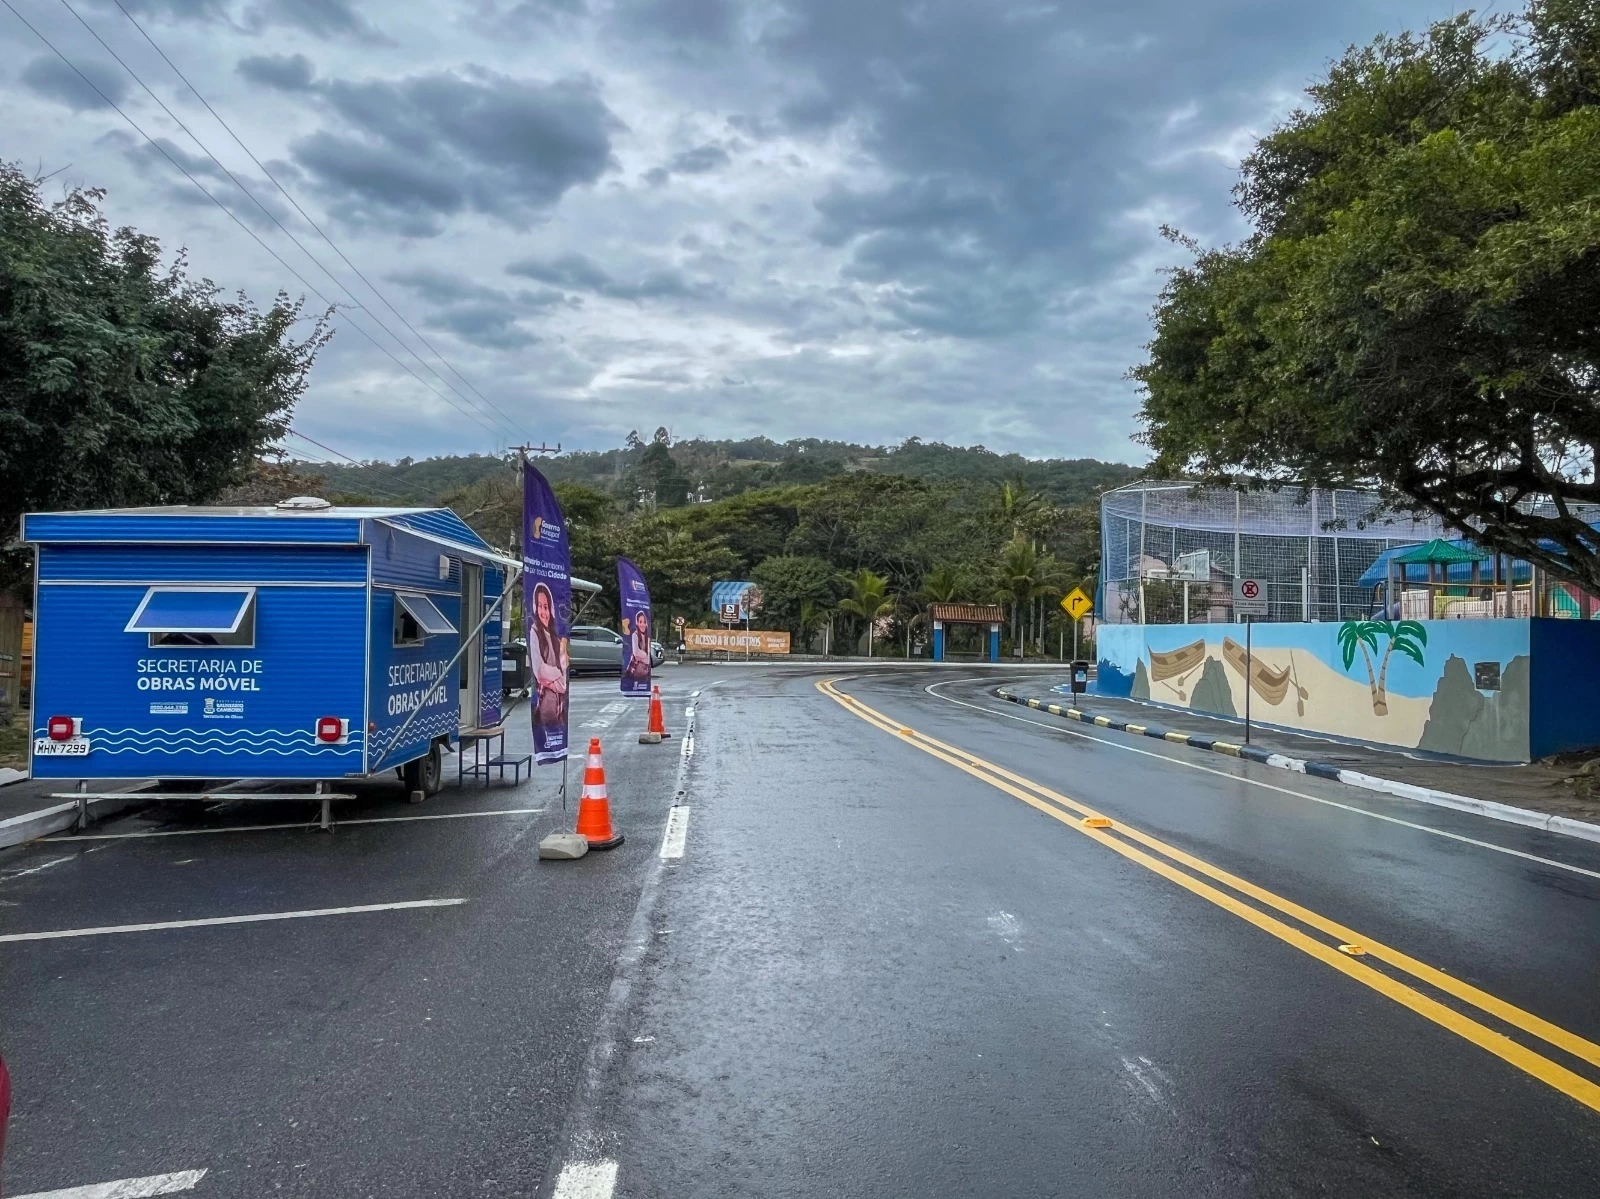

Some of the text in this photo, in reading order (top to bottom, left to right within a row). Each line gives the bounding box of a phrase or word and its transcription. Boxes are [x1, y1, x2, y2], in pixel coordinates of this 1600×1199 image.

[547, 570, 567, 580] Cidade
[695, 635, 717, 645] ACESSO
[736, 636, 761, 647] METROS
[137, 659, 263, 674] SECRETARIA DE
[388, 661, 437, 687] SECRETARIA
[136, 674, 261, 691] OBRAS MÓVEL
[388, 690, 420, 716] OBRAS
[37, 744, 87, 755] MHN-7299
